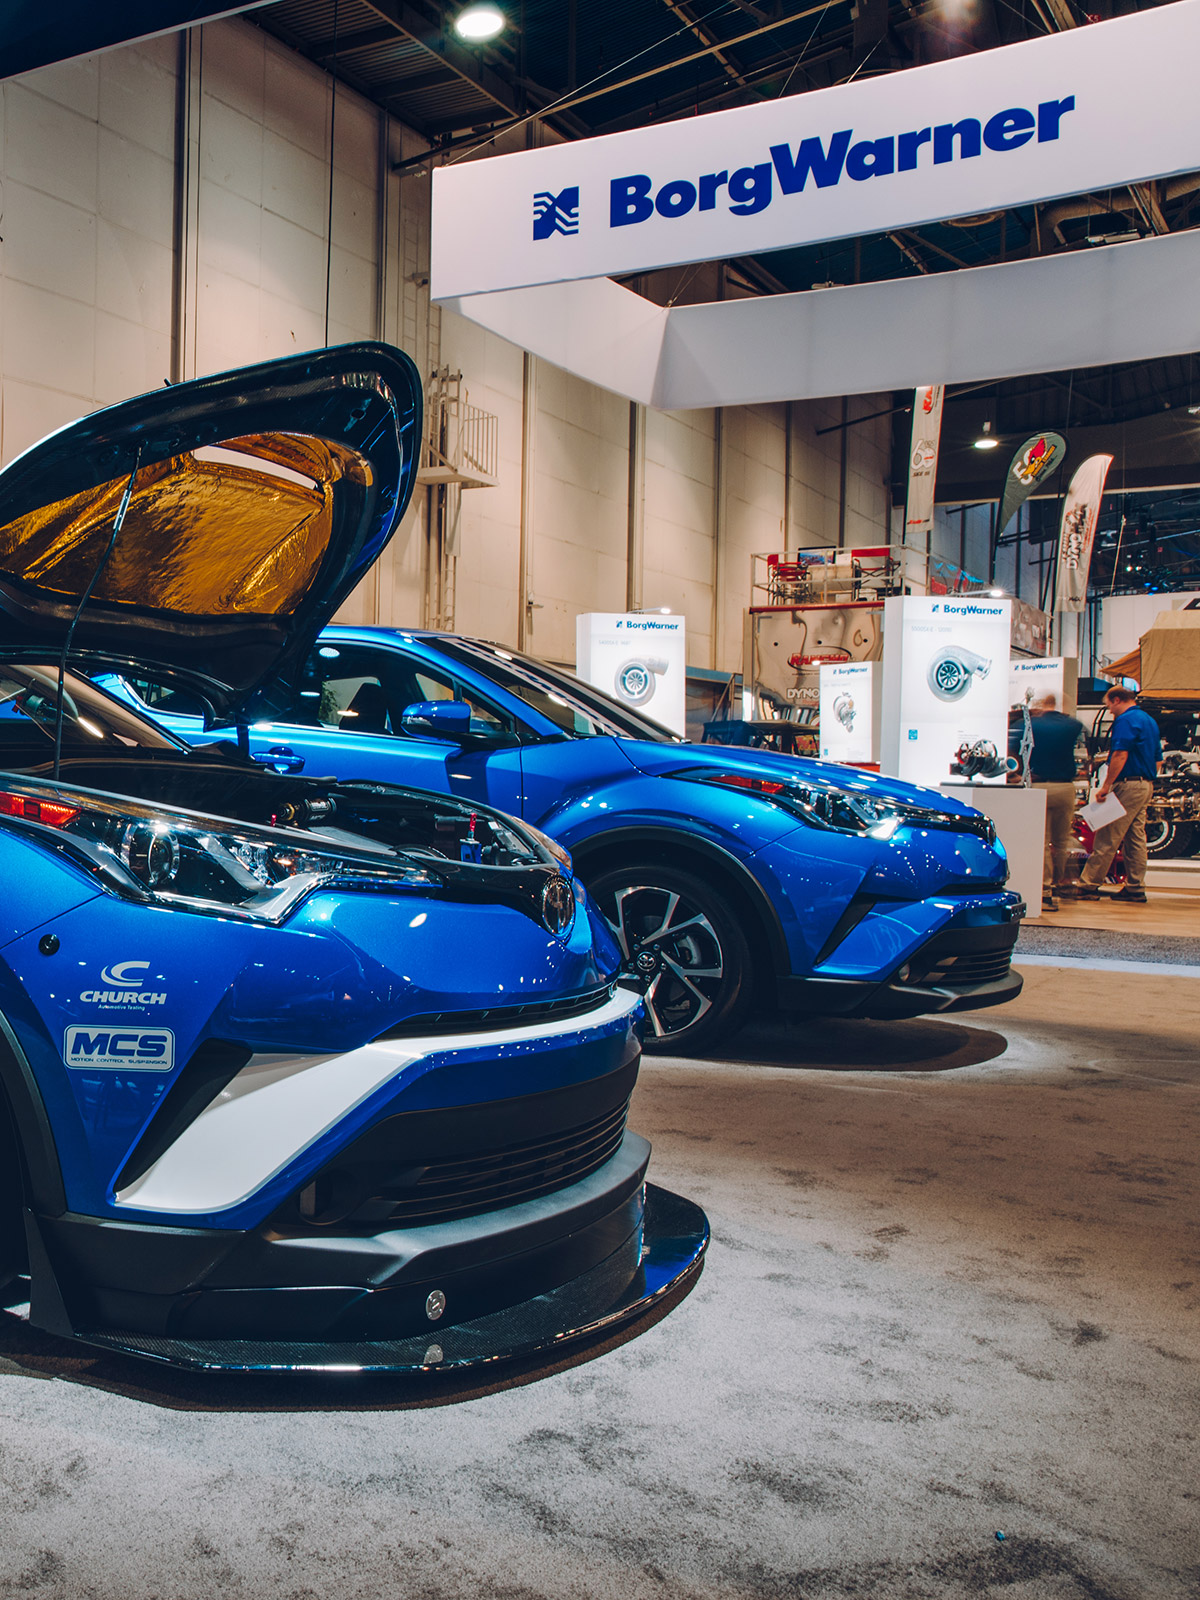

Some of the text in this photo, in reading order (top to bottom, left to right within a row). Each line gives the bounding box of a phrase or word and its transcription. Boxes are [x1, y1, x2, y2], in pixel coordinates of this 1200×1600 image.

[610, 95, 1075, 228] BorgWarner
[943, 604, 1003, 616] BorgWarner
[626, 620, 680, 631] BorgWarner
[1021, 663, 1058, 672] BorgWarner
[79, 990, 167, 1005] CHURCH
[71, 1032, 168, 1057] MCS
